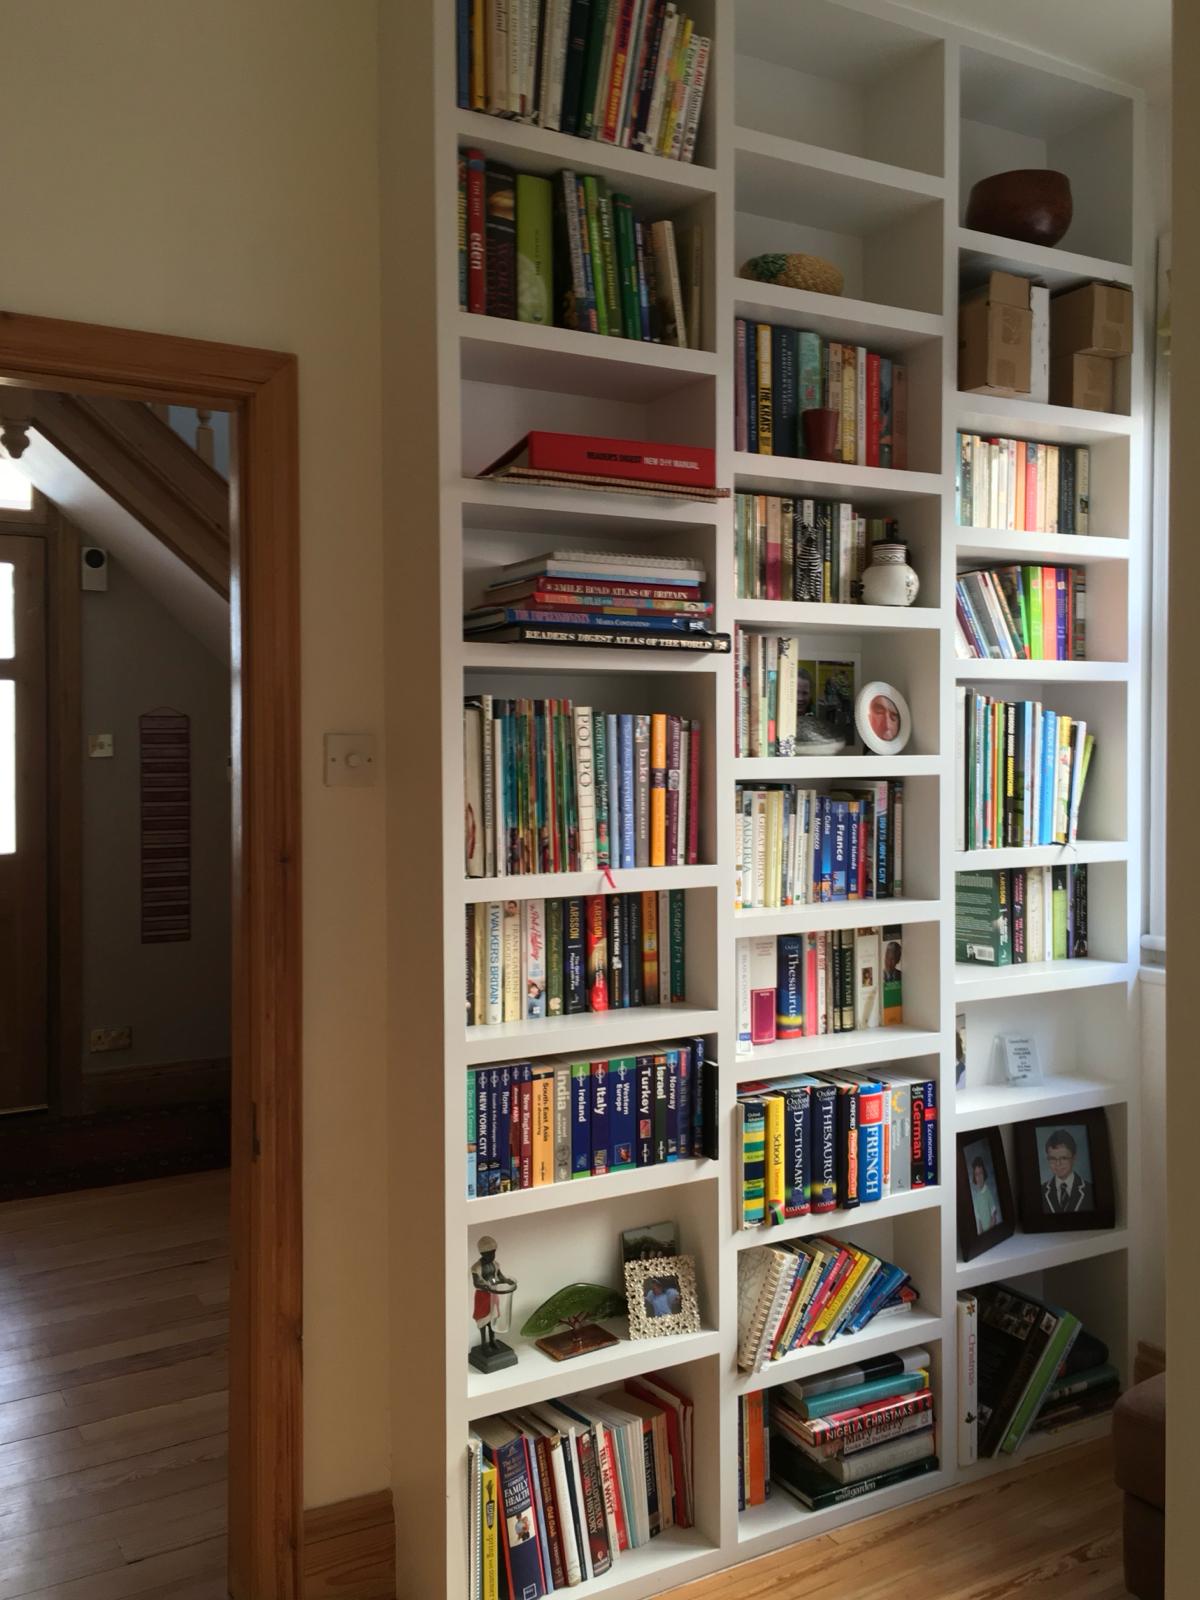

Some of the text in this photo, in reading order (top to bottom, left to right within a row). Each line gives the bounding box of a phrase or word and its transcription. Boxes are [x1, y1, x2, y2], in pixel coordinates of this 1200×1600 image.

[612, 53, 626, 88] Brain
[686, 48, 697, 70] First
[682, 71, 693, 87] Aid
[688, 48, 709, 125] First Aid Manual
[470, 232, 485, 271] eden
[760, 387, 771, 403] THE
[760, 404, 771, 433] KRAYS
[585, 585, 610, 595] ROAD
[611, 587, 640, 597] ATLAS
[640, 589, 652, 598] OF
[653, 590, 688, 600] BRITAIN
[525, 629, 713, 650] READER'S DIGEST ATLAS OF THE WORLD
[577, 714, 593, 788] POLPO
[593, 716, 604, 751] RACHEL
[596, 753, 606, 781] ALLEN
[639, 748, 650, 783] bake
[672, 741, 681, 768] OLIVER
[620, 769, 633, 851] Everyday Kitchen
[824, 815, 832, 835] Cuba
[813, 817, 821, 850] Morocco
[836, 823, 845, 862] France
[879, 817, 887, 840] BOYS
[742, 819, 753, 874] AUSTRIA
[851, 823, 859, 870] Greek Islands
[878, 868, 887, 884] CRY
[569, 900, 580, 939] LARSSON
[592, 900, 603, 938] LARSSON
[612, 905, 620, 917] THE
[612, 938, 620, 956] TIGER
[489, 965, 501, 1005] BRITAIN
[511, 956, 520, 1002] GARDNER
[787, 951, 800, 1020] Thesaurus
[844, 951, 854, 1005] VANITY FAIR
[556, 1070, 571, 1111] India
[614, 1083, 624, 1112] Europe
[622, 1082, 631, 1116] Western
[639, 1067, 652, 1114] Turkey
[656, 1066, 667, 1100] Israel
[666, 1075, 678, 1111] Norway
[501, 1090, 510, 1115] Rome
[512, 1106, 520, 1124] PARIS
[522, 1093, 531, 1109] New
[577, 1088, 587, 1123] Ireland
[593, 1087, 607, 1116] Italy
[478, 1091, 488, 1157] NEW YORK CITY
[521, 1111, 531, 1146] England
[542, 1125, 550, 1142] Asia
[912, 1101, 924, 1159] German
[772, 1134, 783, 1166] School
[793, 1109, 804, 1192] DICTIONARY
[822, 1101, 833, 1186] THESAURUS
[866, 1127, 879, 1194] FRENCH
[927, 1123, 935, 1167] Economics
[826, 1423, 863, 1441] NIGELLA
[866, 1406, 913, 1426] CHRISTMAS
[504, 1479, 529, 1498] FAMILY
[505, 1488, 531, 1507] HEALTH
[582, 1462, 597, 1535] WORLD HISTORY
[587, 1462, 602, 1518] ENCYCLOPEDIA
[599, 1447, 615, 1516] TELL ME WHY?
